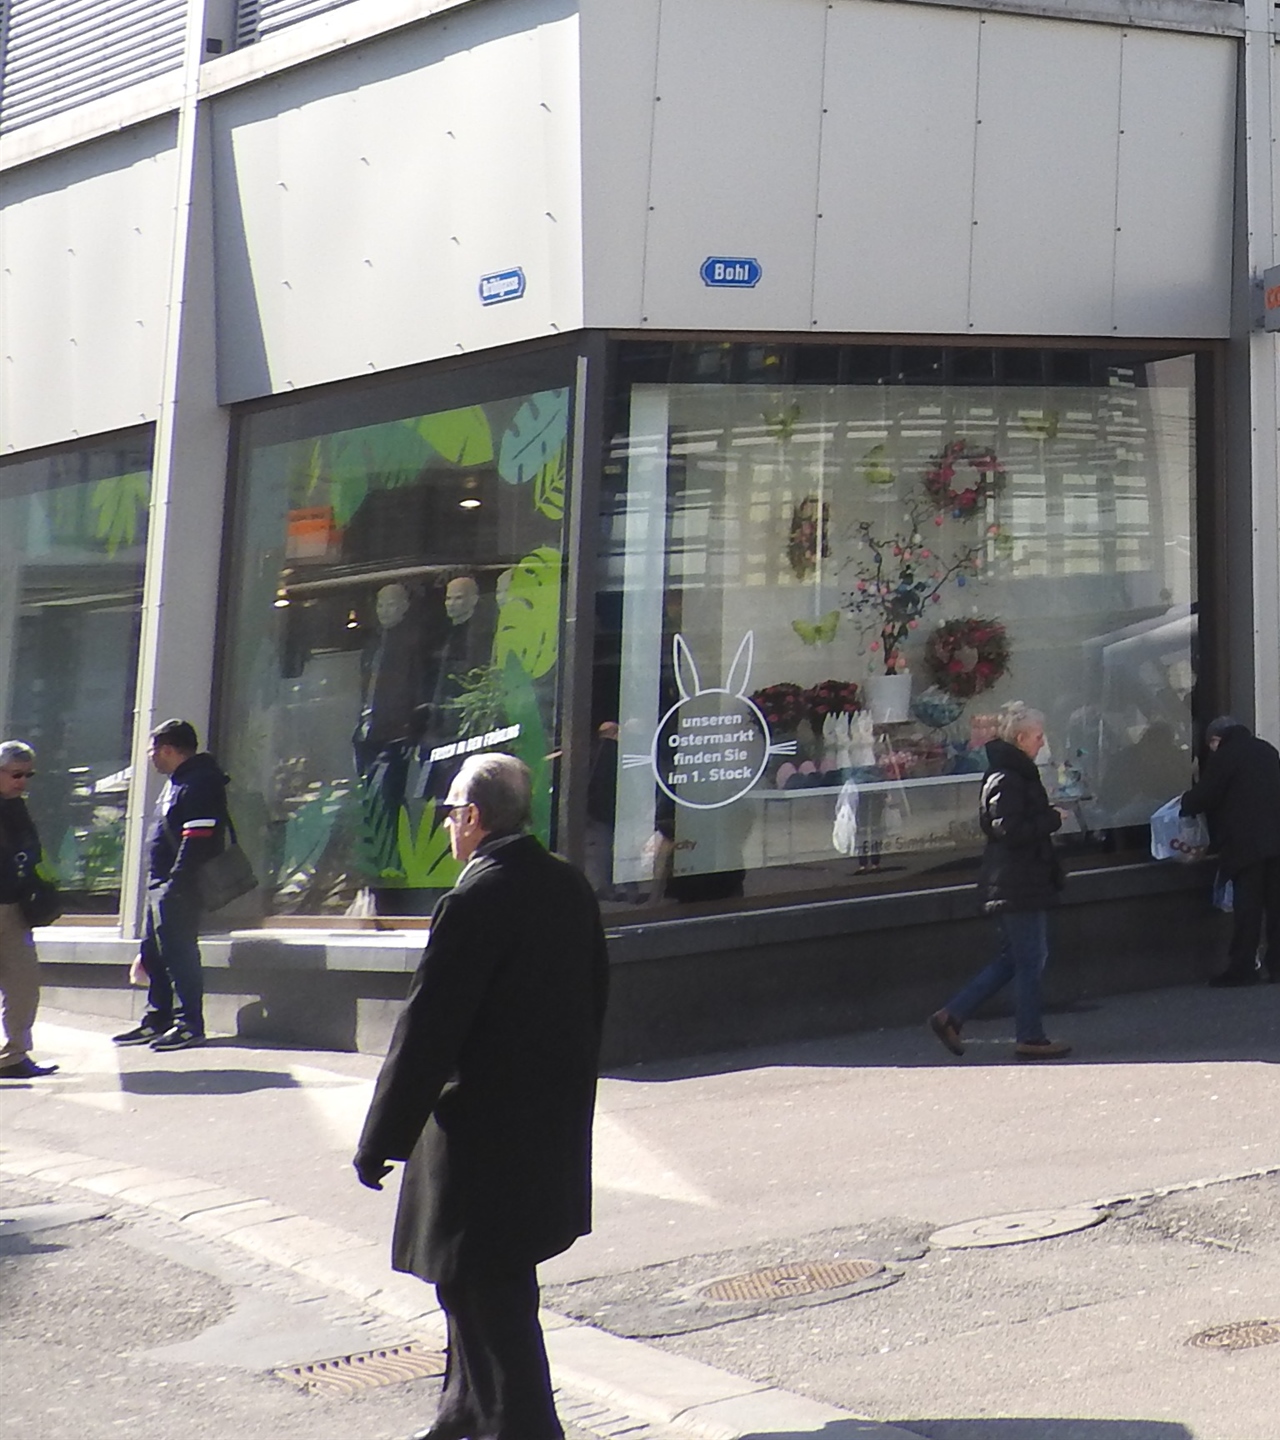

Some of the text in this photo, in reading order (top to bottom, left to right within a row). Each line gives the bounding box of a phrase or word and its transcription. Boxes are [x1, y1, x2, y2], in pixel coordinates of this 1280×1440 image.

[713, 263, 749, 281] Bohl
[682, 714, 742, 728] unseren
[668, 729, 754, 748] Ostermarkt
[673, 748, 748, 766] finden Sie
[667, 765, 752, 785] im 1. Stock
